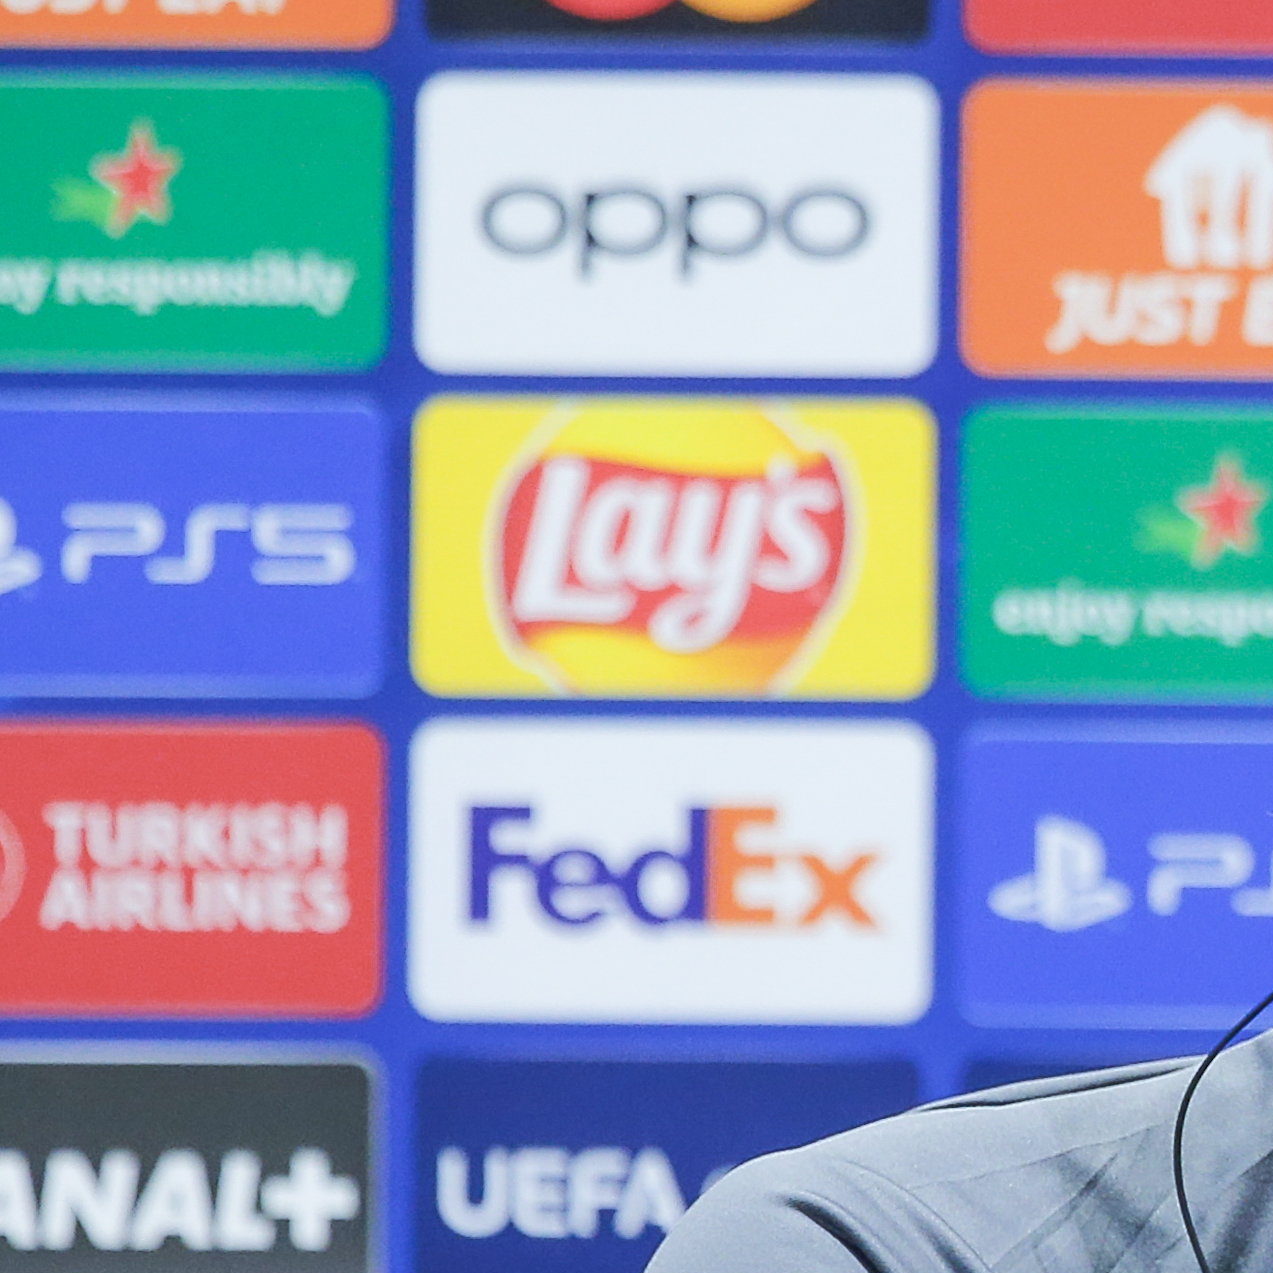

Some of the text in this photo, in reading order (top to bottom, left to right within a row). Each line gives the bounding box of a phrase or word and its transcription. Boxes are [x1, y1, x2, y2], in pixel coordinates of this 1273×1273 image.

[476, 180, 874, 281] oppo
[1046, 271, 1234, 353] JUST
[61, 504, 356, 585] PS5
[512, 455, 839, 652] Lay's
[43, 801, 348, 868] TURKISH
[465, 803, 874, 930] FedEx
[40, 868, 350, 933] AIRLINES
[436, 1146, 690, 1239] UEFA
